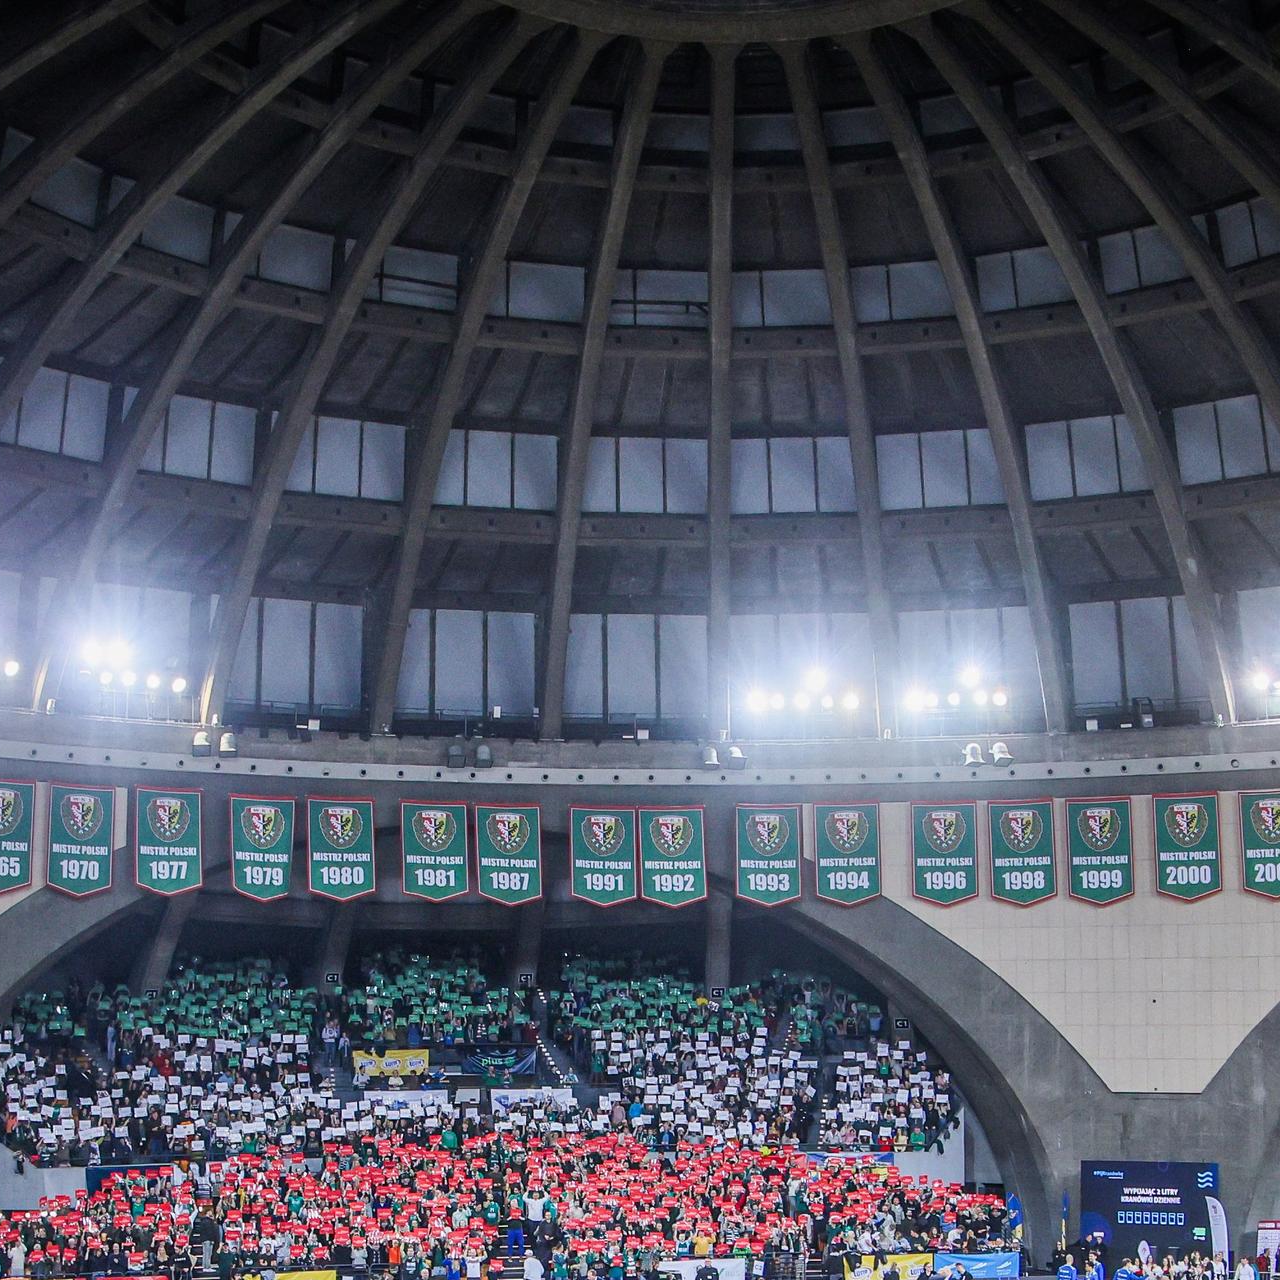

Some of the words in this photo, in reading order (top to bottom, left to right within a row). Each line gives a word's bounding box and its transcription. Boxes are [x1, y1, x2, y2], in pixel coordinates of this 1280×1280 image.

[2, 841, 27, 852] POLSKI
[53, 843, 80, 855] MISTRZ
[81, 845, 108, 856] POLSKI
[141, 846, 168, 856] MISTRZ
[170, 847, 196, 859] POLSKI
[236, 851, 263, 861] MISTRZ
[265, 852, 289, 863] POLSK
[313, 852, 341, 861] MISTRZ
[343, 852, 370, 862] POLSKI
[406, 854, 435, 864] MISTRZ
[436, 856, 463, 865] POLSKI
[1160, 851, 1188, 861] MISTRZ
[1189, 851, 1216, 860] POLSKI
[1247, 849, 1275, 858] MISTRZ
[481, 857, 508, 867] MISTRZ
[510, 859, 536, 869] POLSKI
[575, 859, 603, 868] MISTRZ
[604, 860, 631, 870] POLSKI
[644, 860, 672, 869] MISTRZ
[674, 860, 700, 869] POLSKI
[740, 859, 768, 868] MISTRZ
[769, 859, 796, 869] POLSKI
[820, 858, 848, 867] MISTRZ
[849, 857, 876, 867] POLSKI
[917, 858, 945, 867] MISTRZ
[946, 857, 973, 866] POLSKI
[995, 857, 1023, 867] MISTRZ
[1024, 856, 1051, 866] POLSKI
[1072, 857, 1100, 866] MISTRZ
[1101, 855, 1128, 865] POLSKI
[60, 860, 99, 880] 1970
[149, 861, 187, 879] 1977
[243, 866, 283, 885] 1979
[320, 867, 364, 885] 1980
[1166, 865, 1211, 885] 2000
[415, 869, 455, 887] 1981
[490, 872, 529, 890] 1987
[584, 873, 624, 891] 1991
[652, 873, 694, 892] 1992
[747, 873, 789, 892] 1993
[827, 871, 869, 890] 1994
[924, 872, 967, 889] 1996
[1002, 871, 1044, 890] 1998
[1080, 869, 1122, 889] 1999
[520, 974, 531, 982] C1
[713, 989, 723, 997] C1
[897, 1020, 908, 1028] C1
[482, 1057, 503, 1066] plus
[1162, 1188, 1179, 1196] LITRY
